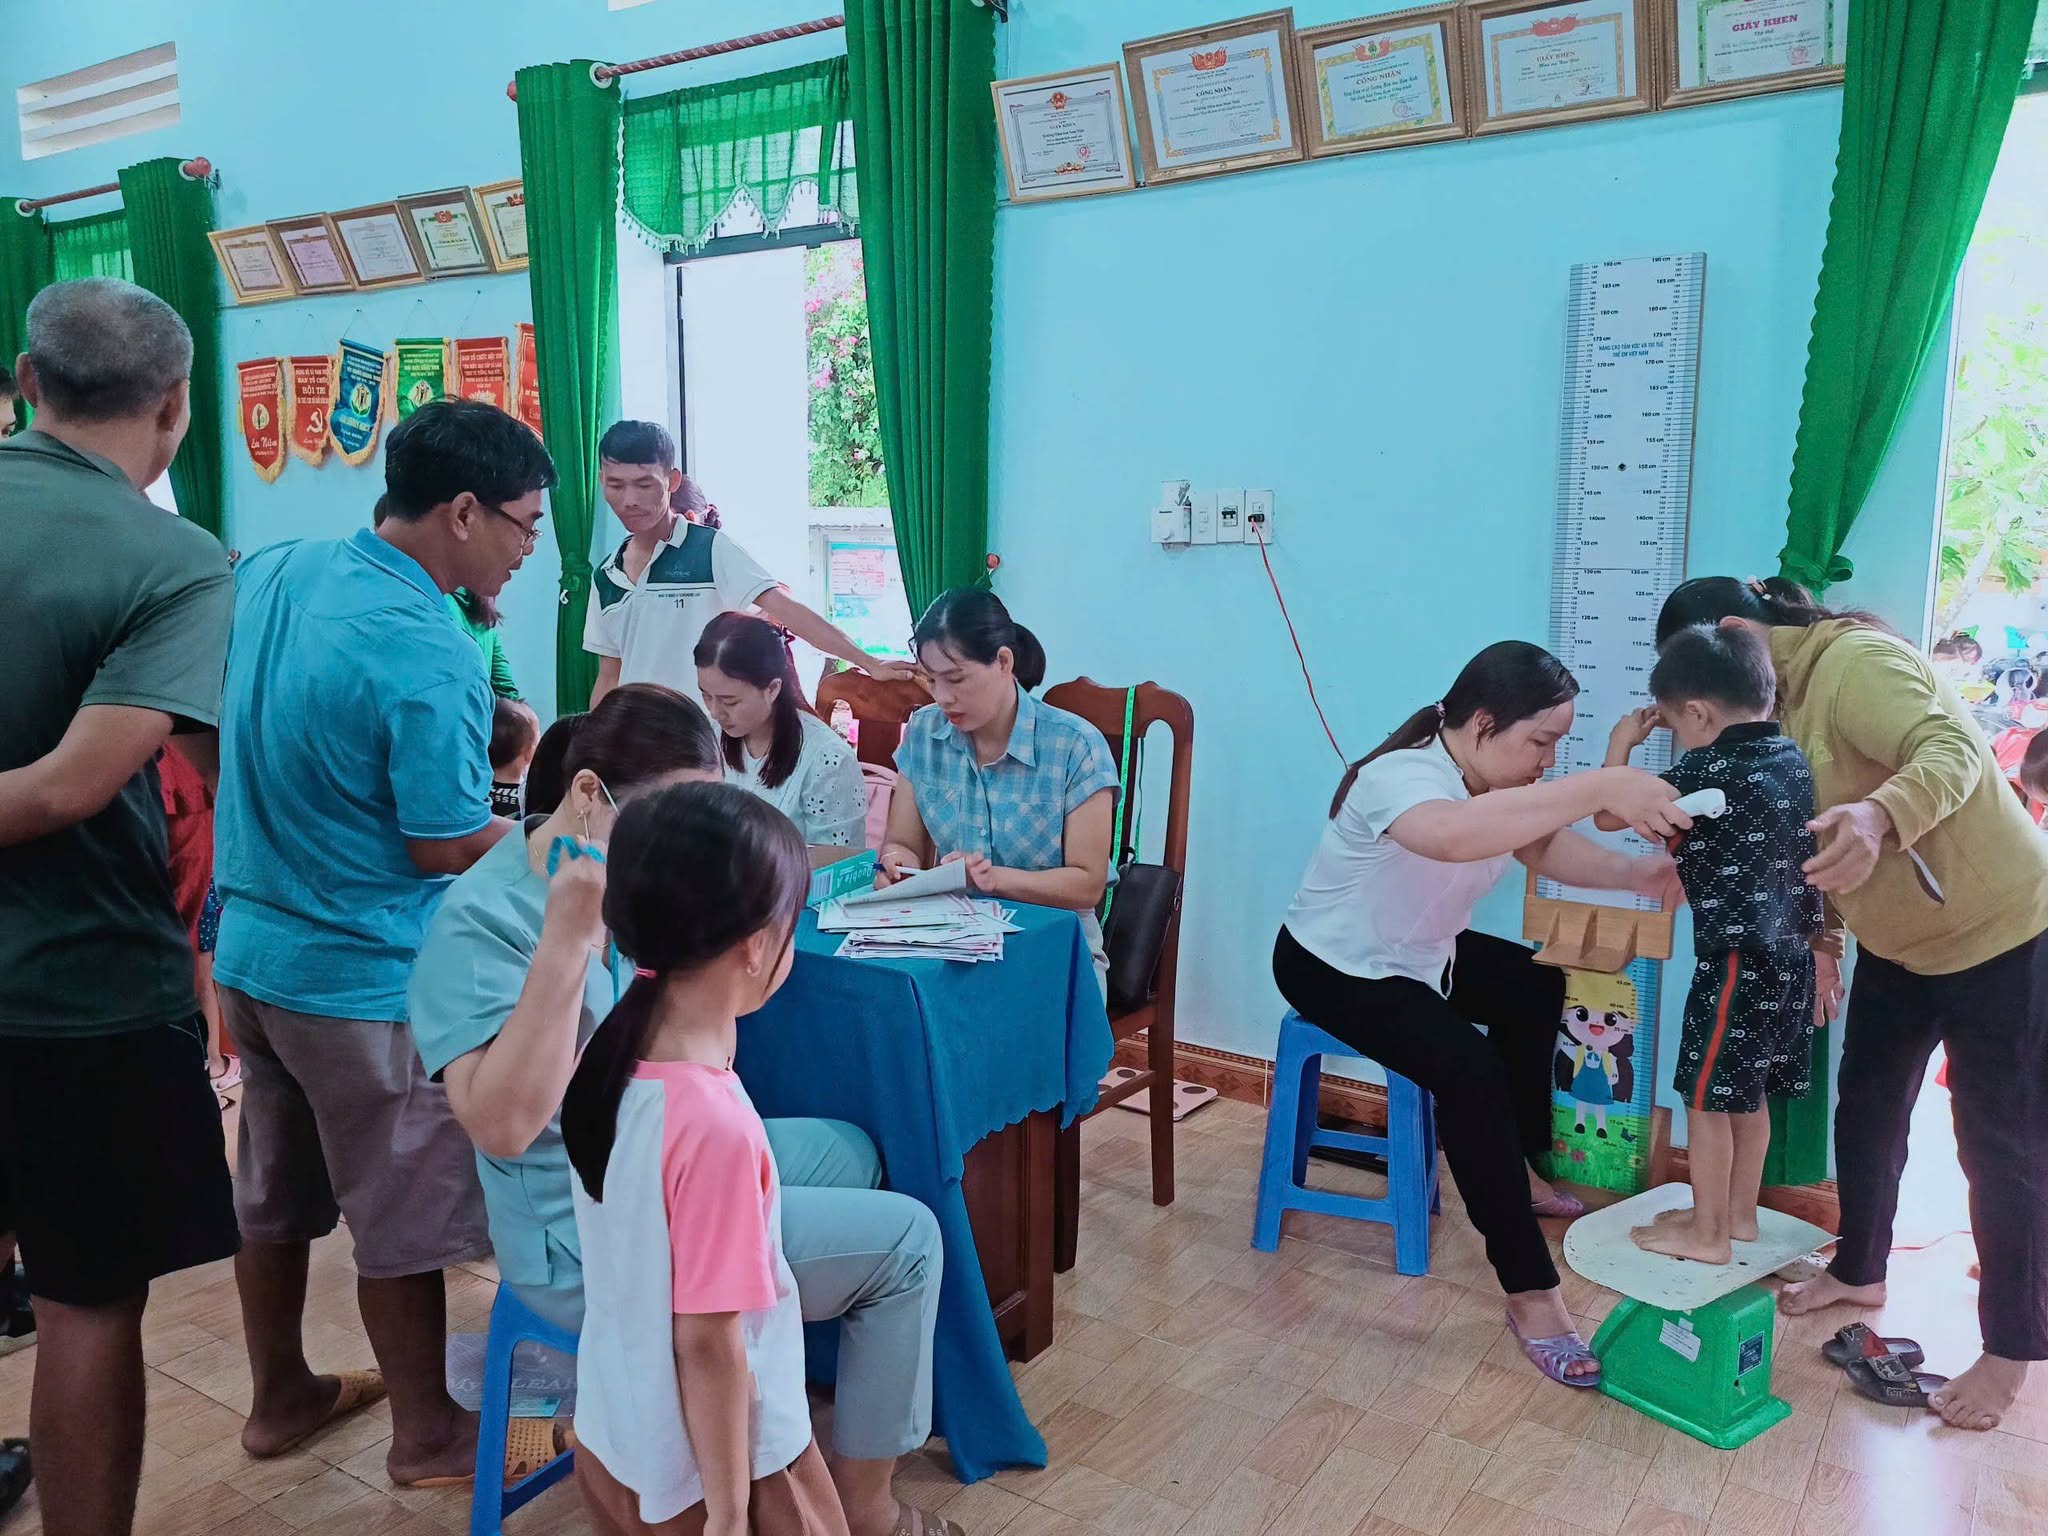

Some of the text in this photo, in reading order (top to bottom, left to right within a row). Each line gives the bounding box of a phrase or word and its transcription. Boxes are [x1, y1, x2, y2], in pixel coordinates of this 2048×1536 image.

[1763, 14, 1798, 27] KHEN
[1356, 75, 1378, 85] CÔNG
[315, 386, 327, 395] THI
[673, 598, 684, 609] 11
[845, 866, 873, 884] Double
